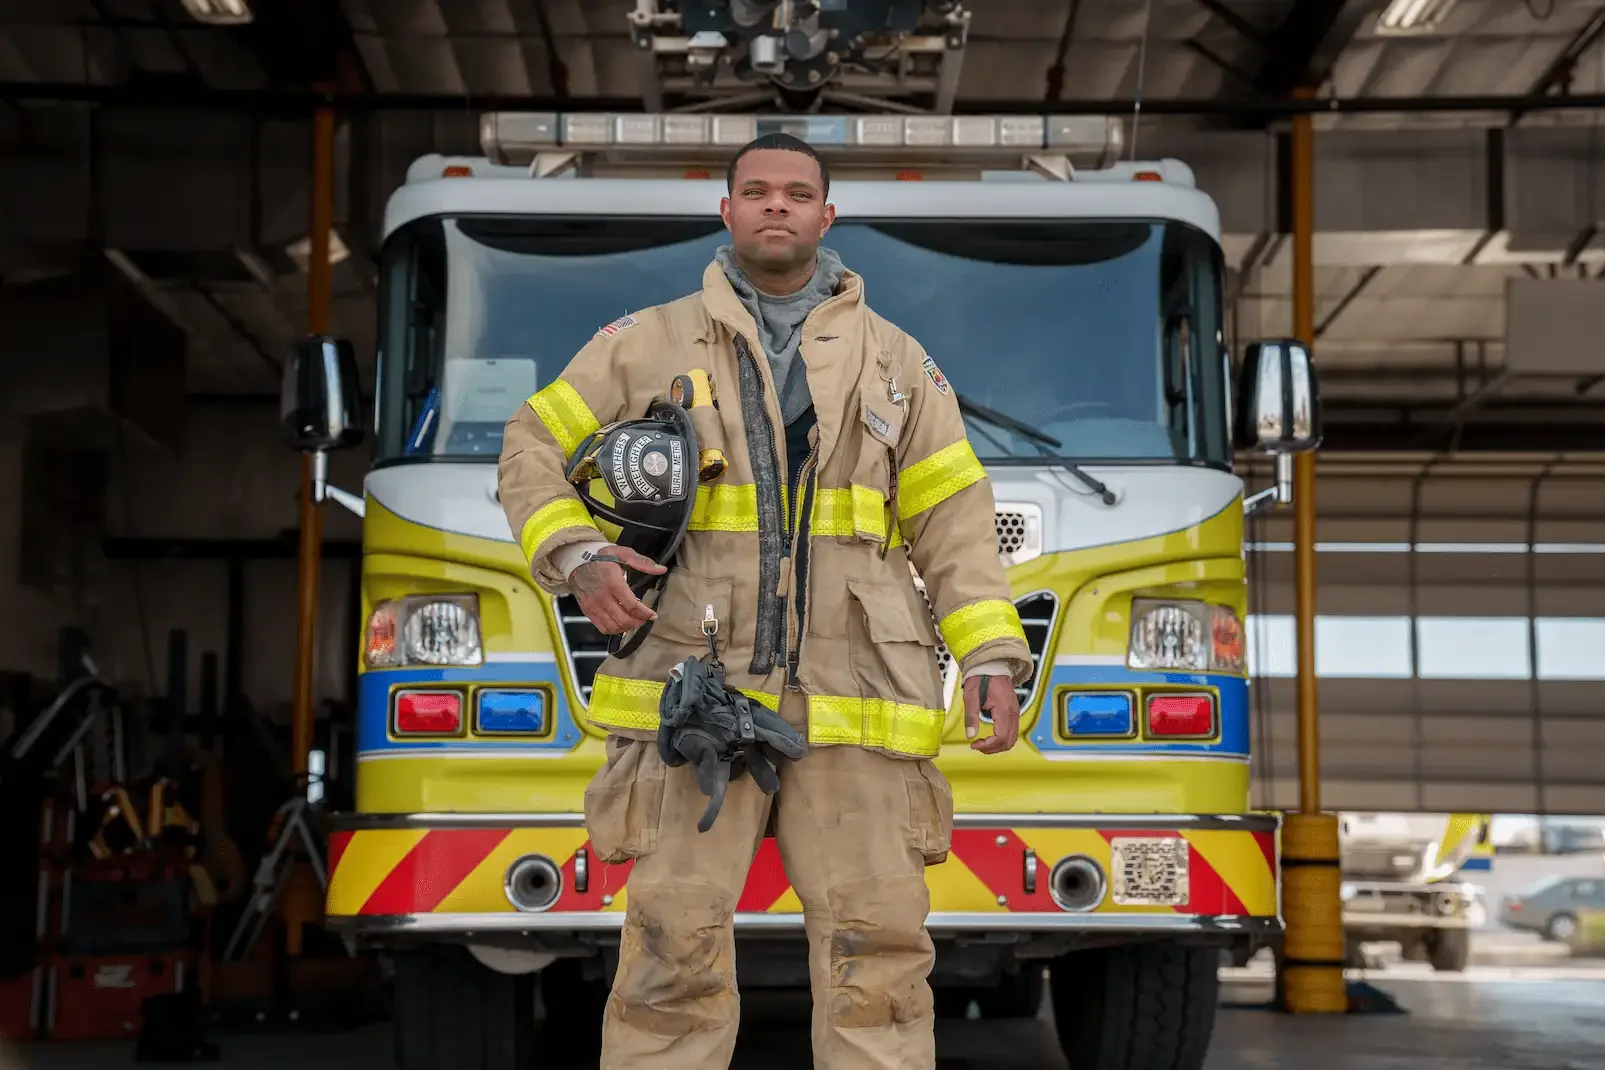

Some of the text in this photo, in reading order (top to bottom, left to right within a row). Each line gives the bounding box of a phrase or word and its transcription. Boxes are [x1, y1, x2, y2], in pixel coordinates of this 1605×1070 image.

[613, 437, 628, 491] WEATHERS
[630, 436, 651, 494] FIREFIGHTER
[671, 441, 681, 494] RURAL METRO
